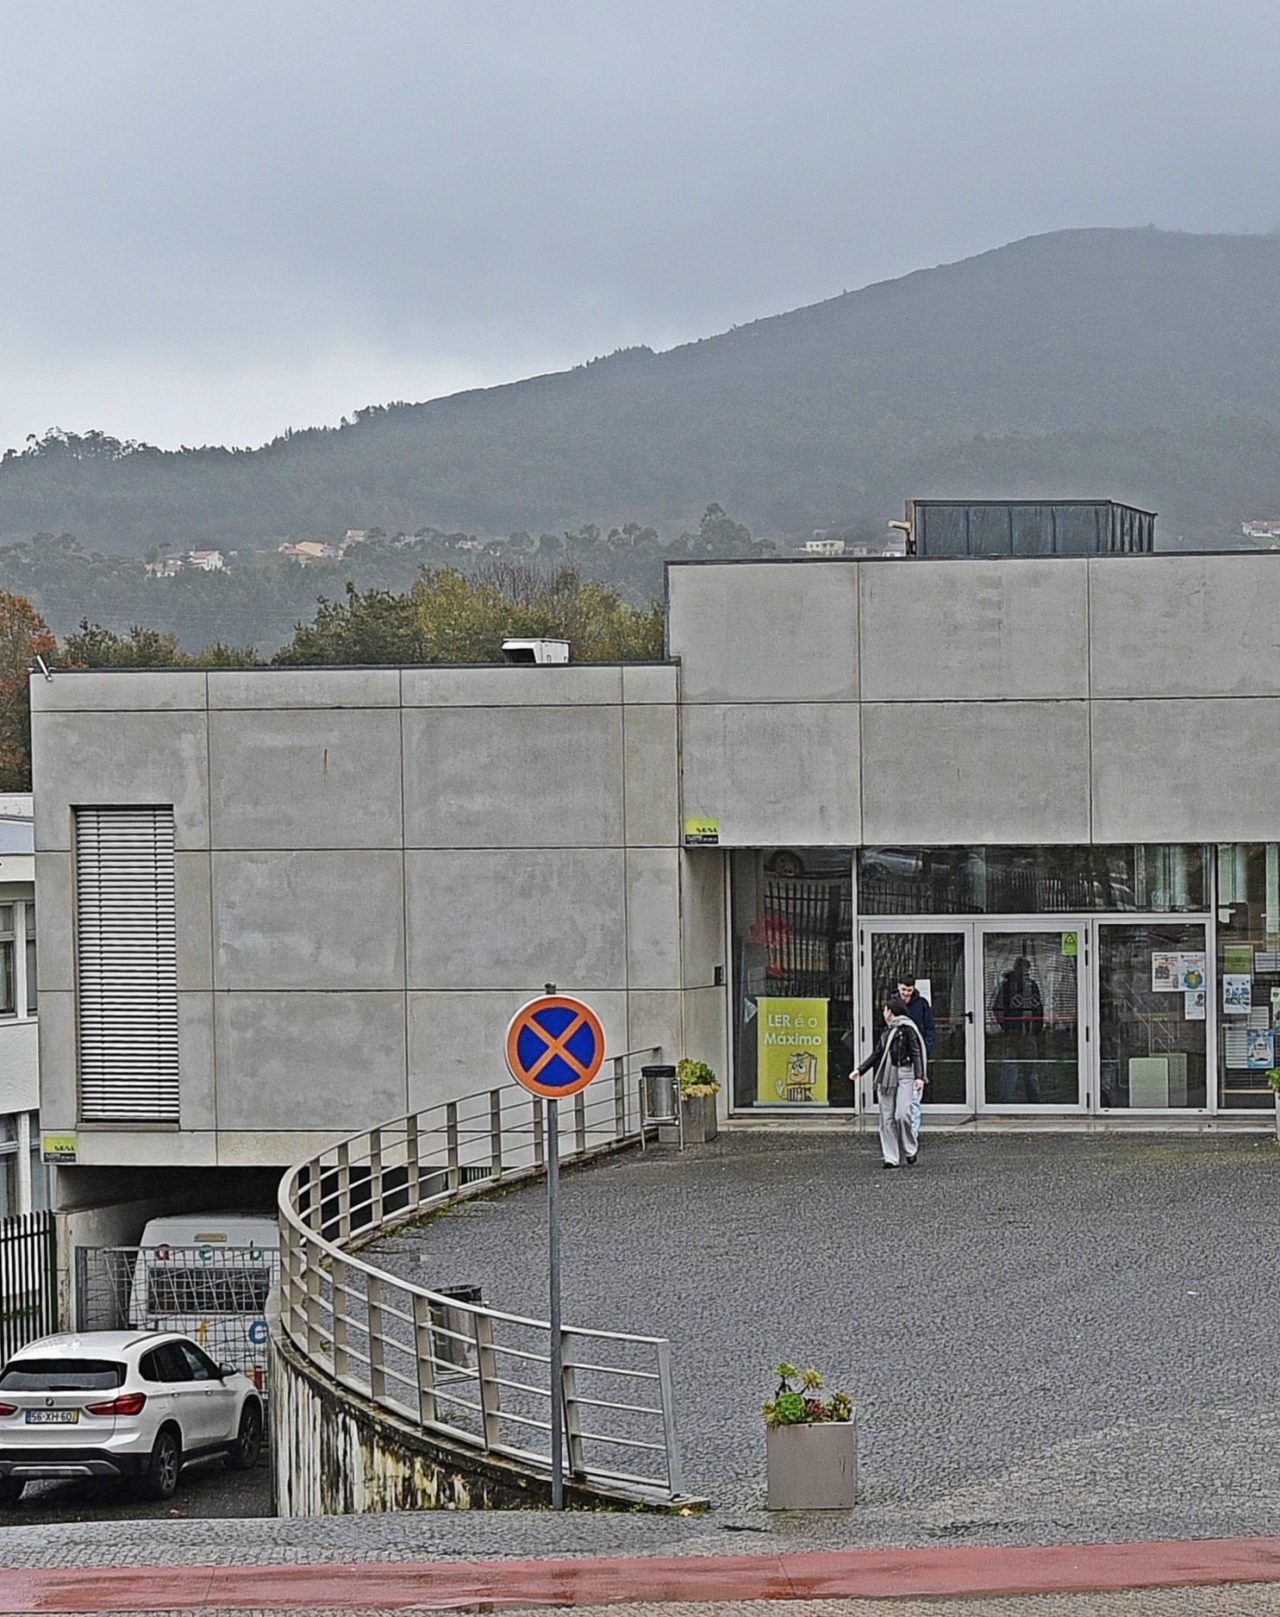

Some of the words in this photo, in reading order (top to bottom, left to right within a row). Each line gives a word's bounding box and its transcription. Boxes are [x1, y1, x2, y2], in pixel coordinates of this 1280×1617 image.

[768, 1014, 790, 1027] LER
[794, 1013, 804, 1028] é
[807, 1017, 818, 1028] o
[764, 1031, 822, 1046] Máximo
